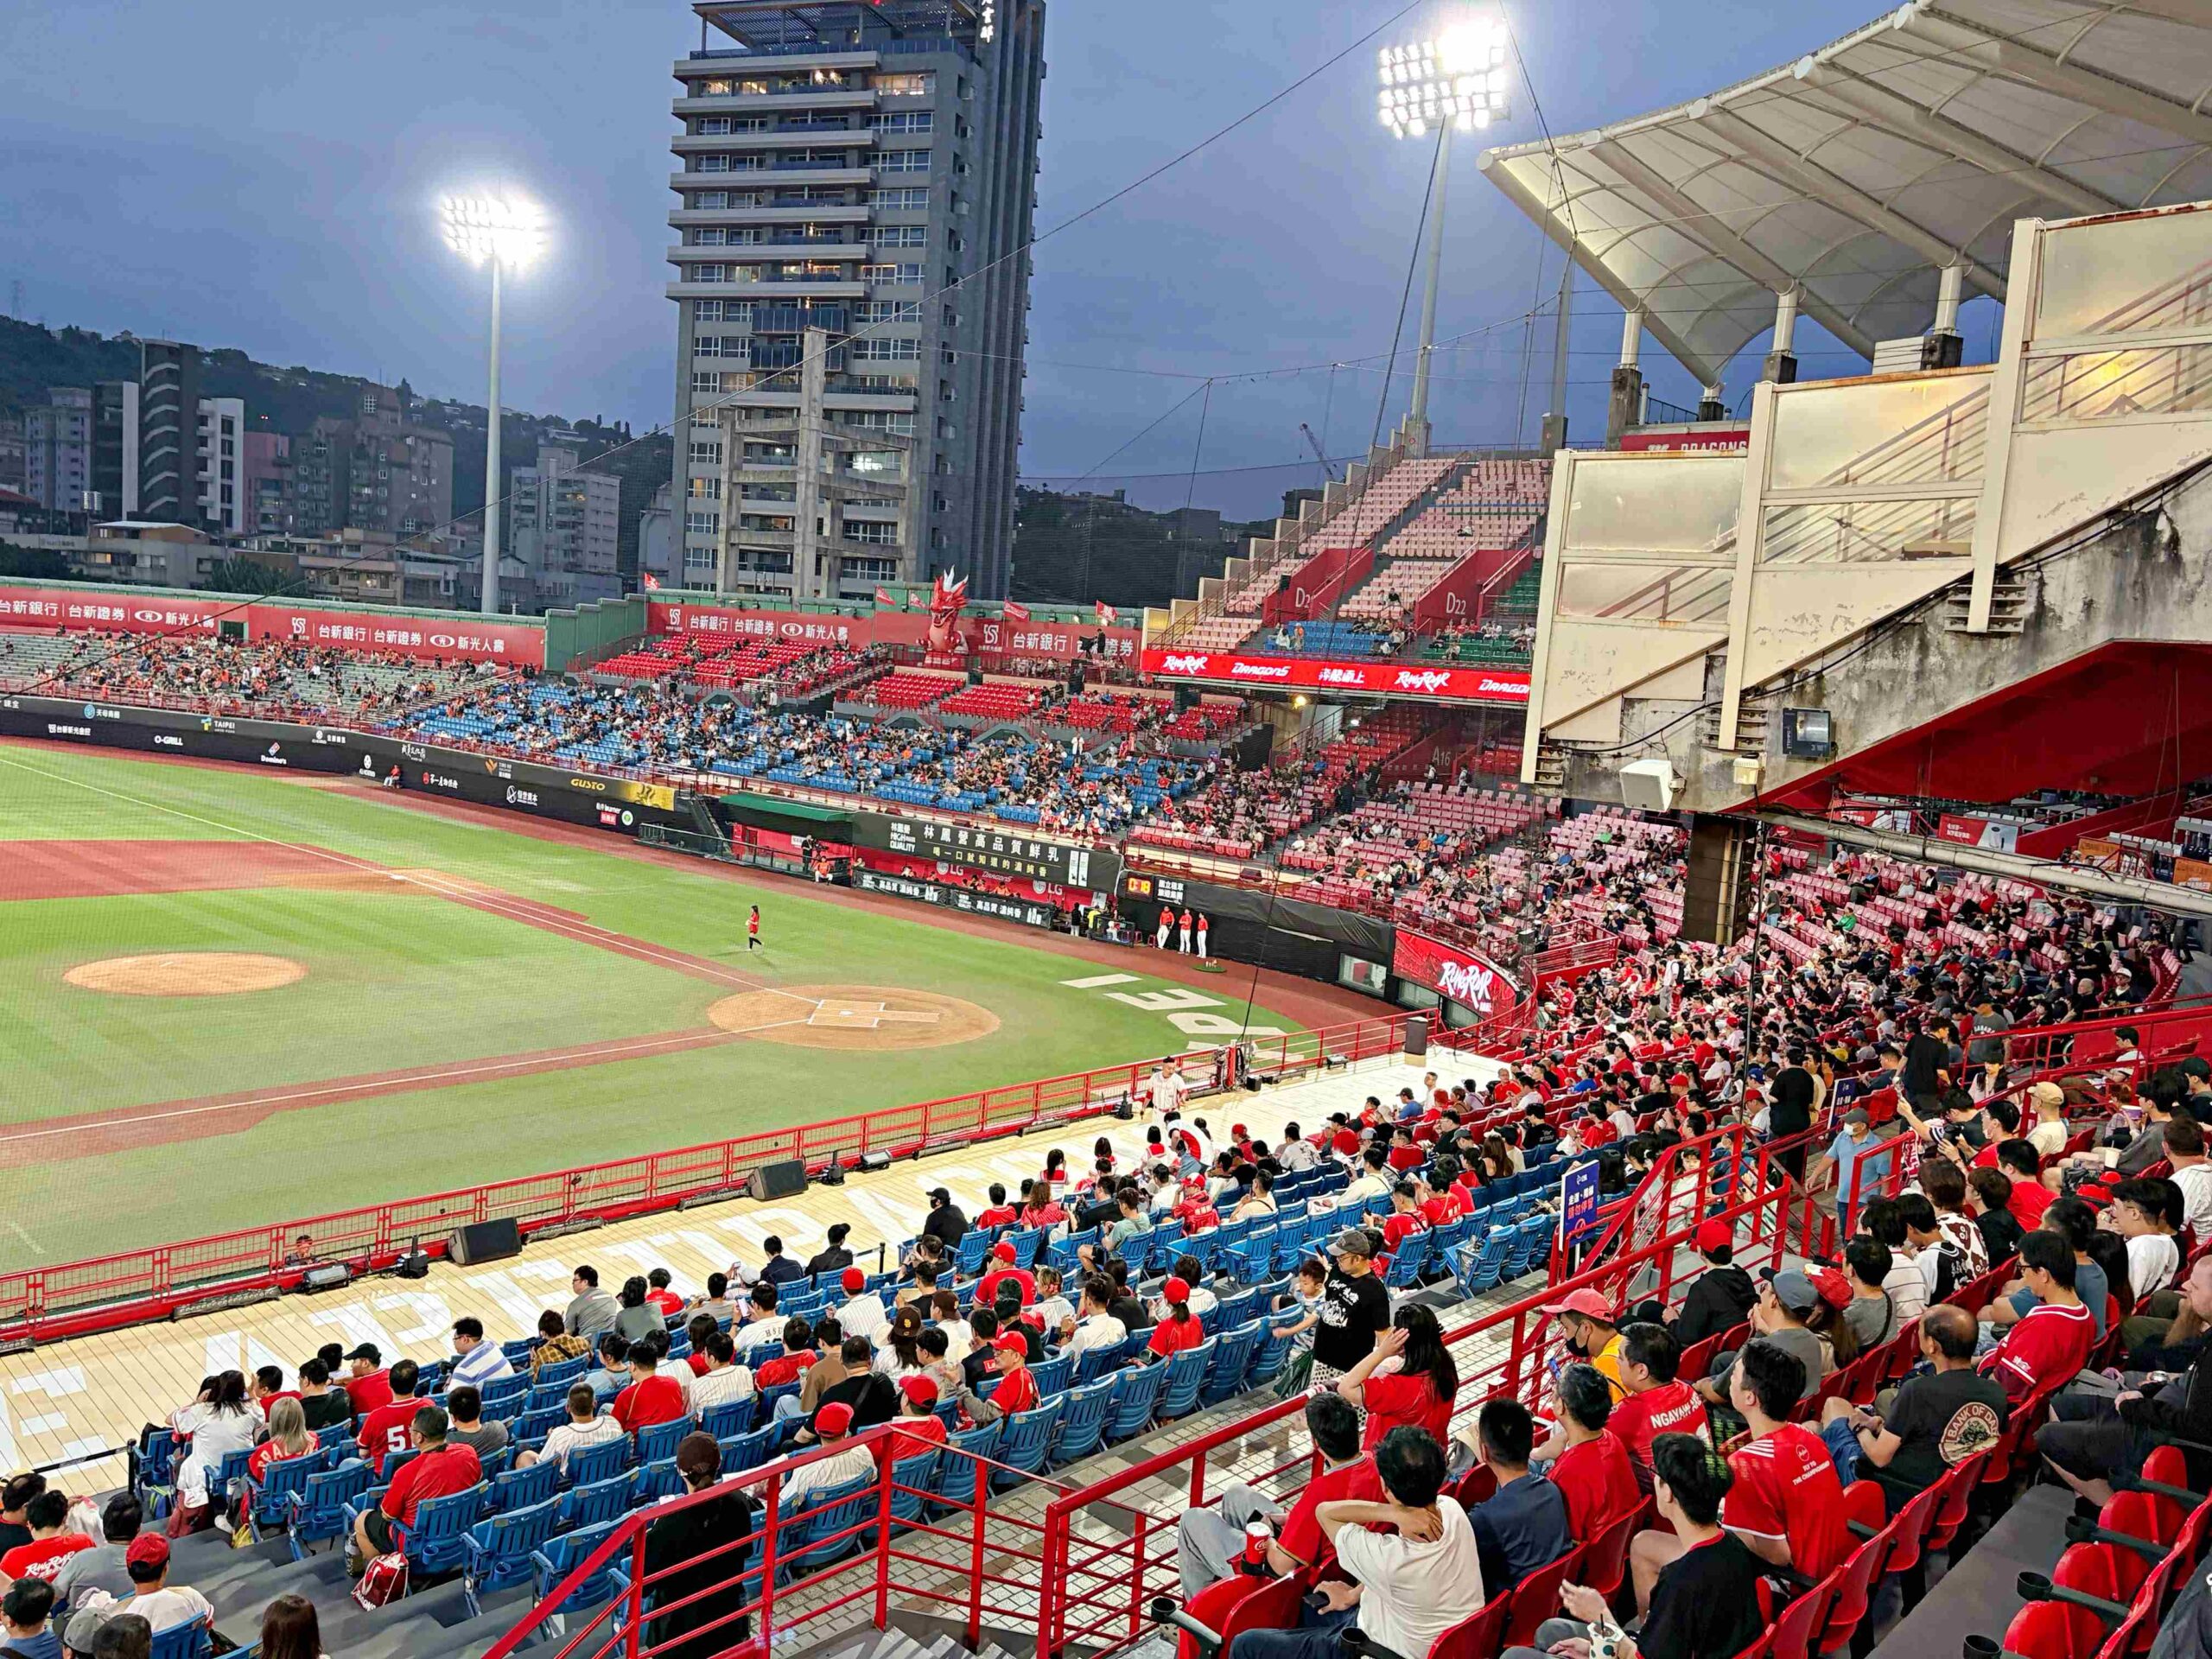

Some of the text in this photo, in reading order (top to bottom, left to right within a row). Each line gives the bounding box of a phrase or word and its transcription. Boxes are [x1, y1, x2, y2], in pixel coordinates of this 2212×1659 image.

[1446, 591, 1467, 615] D22
[68, 604, 125, 622] 台新證券
[165, 610, 215, 629] 新光人壽
[319, 624, 505, 653] 台新銀行 台新證券 新光人壽
[690, 615, 849, 642] 台新銀行 台新證券 新光人壽
[1013, 632, 1068, 653] 台新銀行
[213, 721, 236, 730] TAIPEI
[154, 734, 184, 747] O-GRILL
[1432, 746, 1452, 767] A16
[570, 778, 606, 791] GUSTO
[889, 840, 916, 853] QUALITY
[950, 865, 964, 876] LG
[1046, 883, 1064, 896] LG
[1948, 1406, 1971, 1438] BANK
[1971, 1405, 1985, 1416] OF
